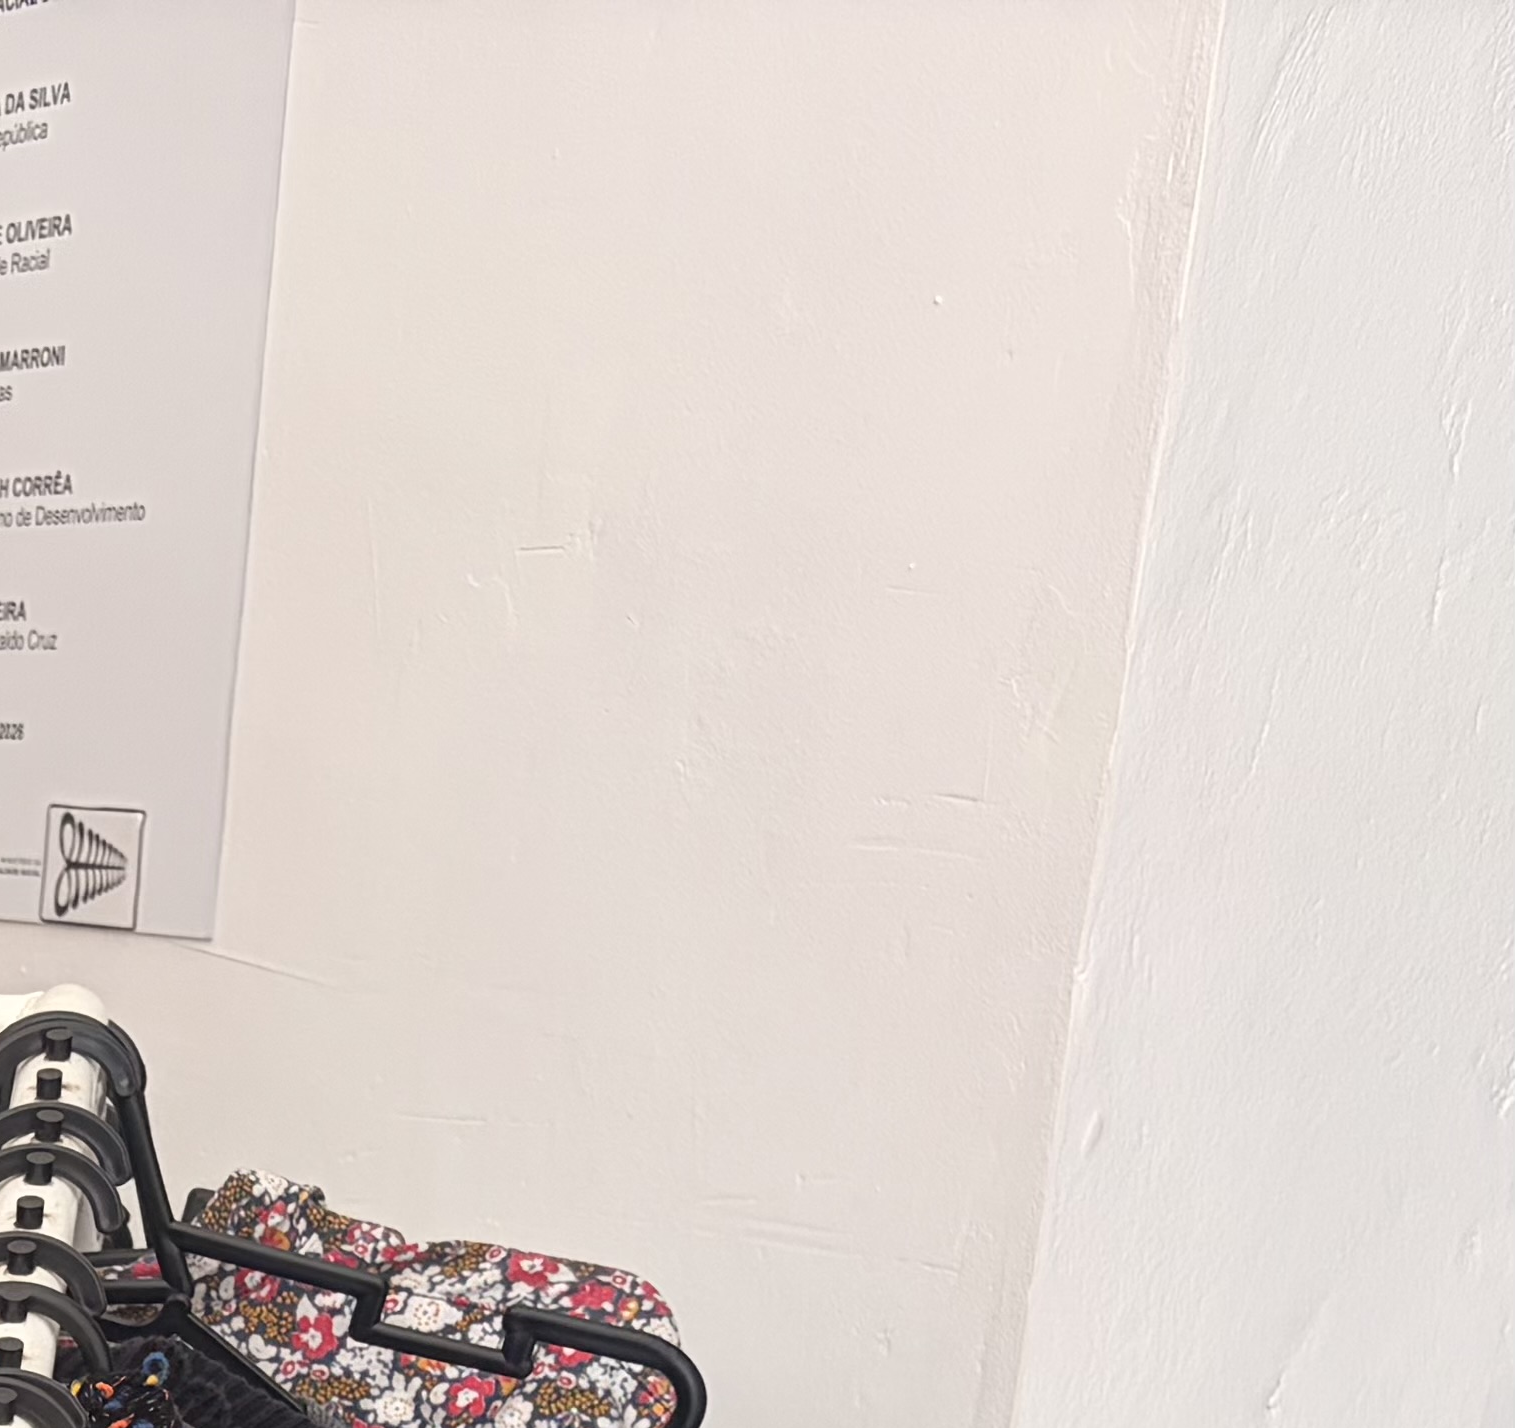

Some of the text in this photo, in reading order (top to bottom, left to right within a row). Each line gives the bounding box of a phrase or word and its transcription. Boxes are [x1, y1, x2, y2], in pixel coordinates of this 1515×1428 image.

[4, 91, 25, 115] DA
[28, 81, 71, 110] SILVA
[6, 213, 73, 244] OLIVEIRA
[11, 249, 51, 274] Racial
[12, 470, 73, 497] CORRÊA
[16, 507, 31, 527] de
[35, 501, 146, 527] Desenvolvimento
[27, 629, 58, 650] Cruz
